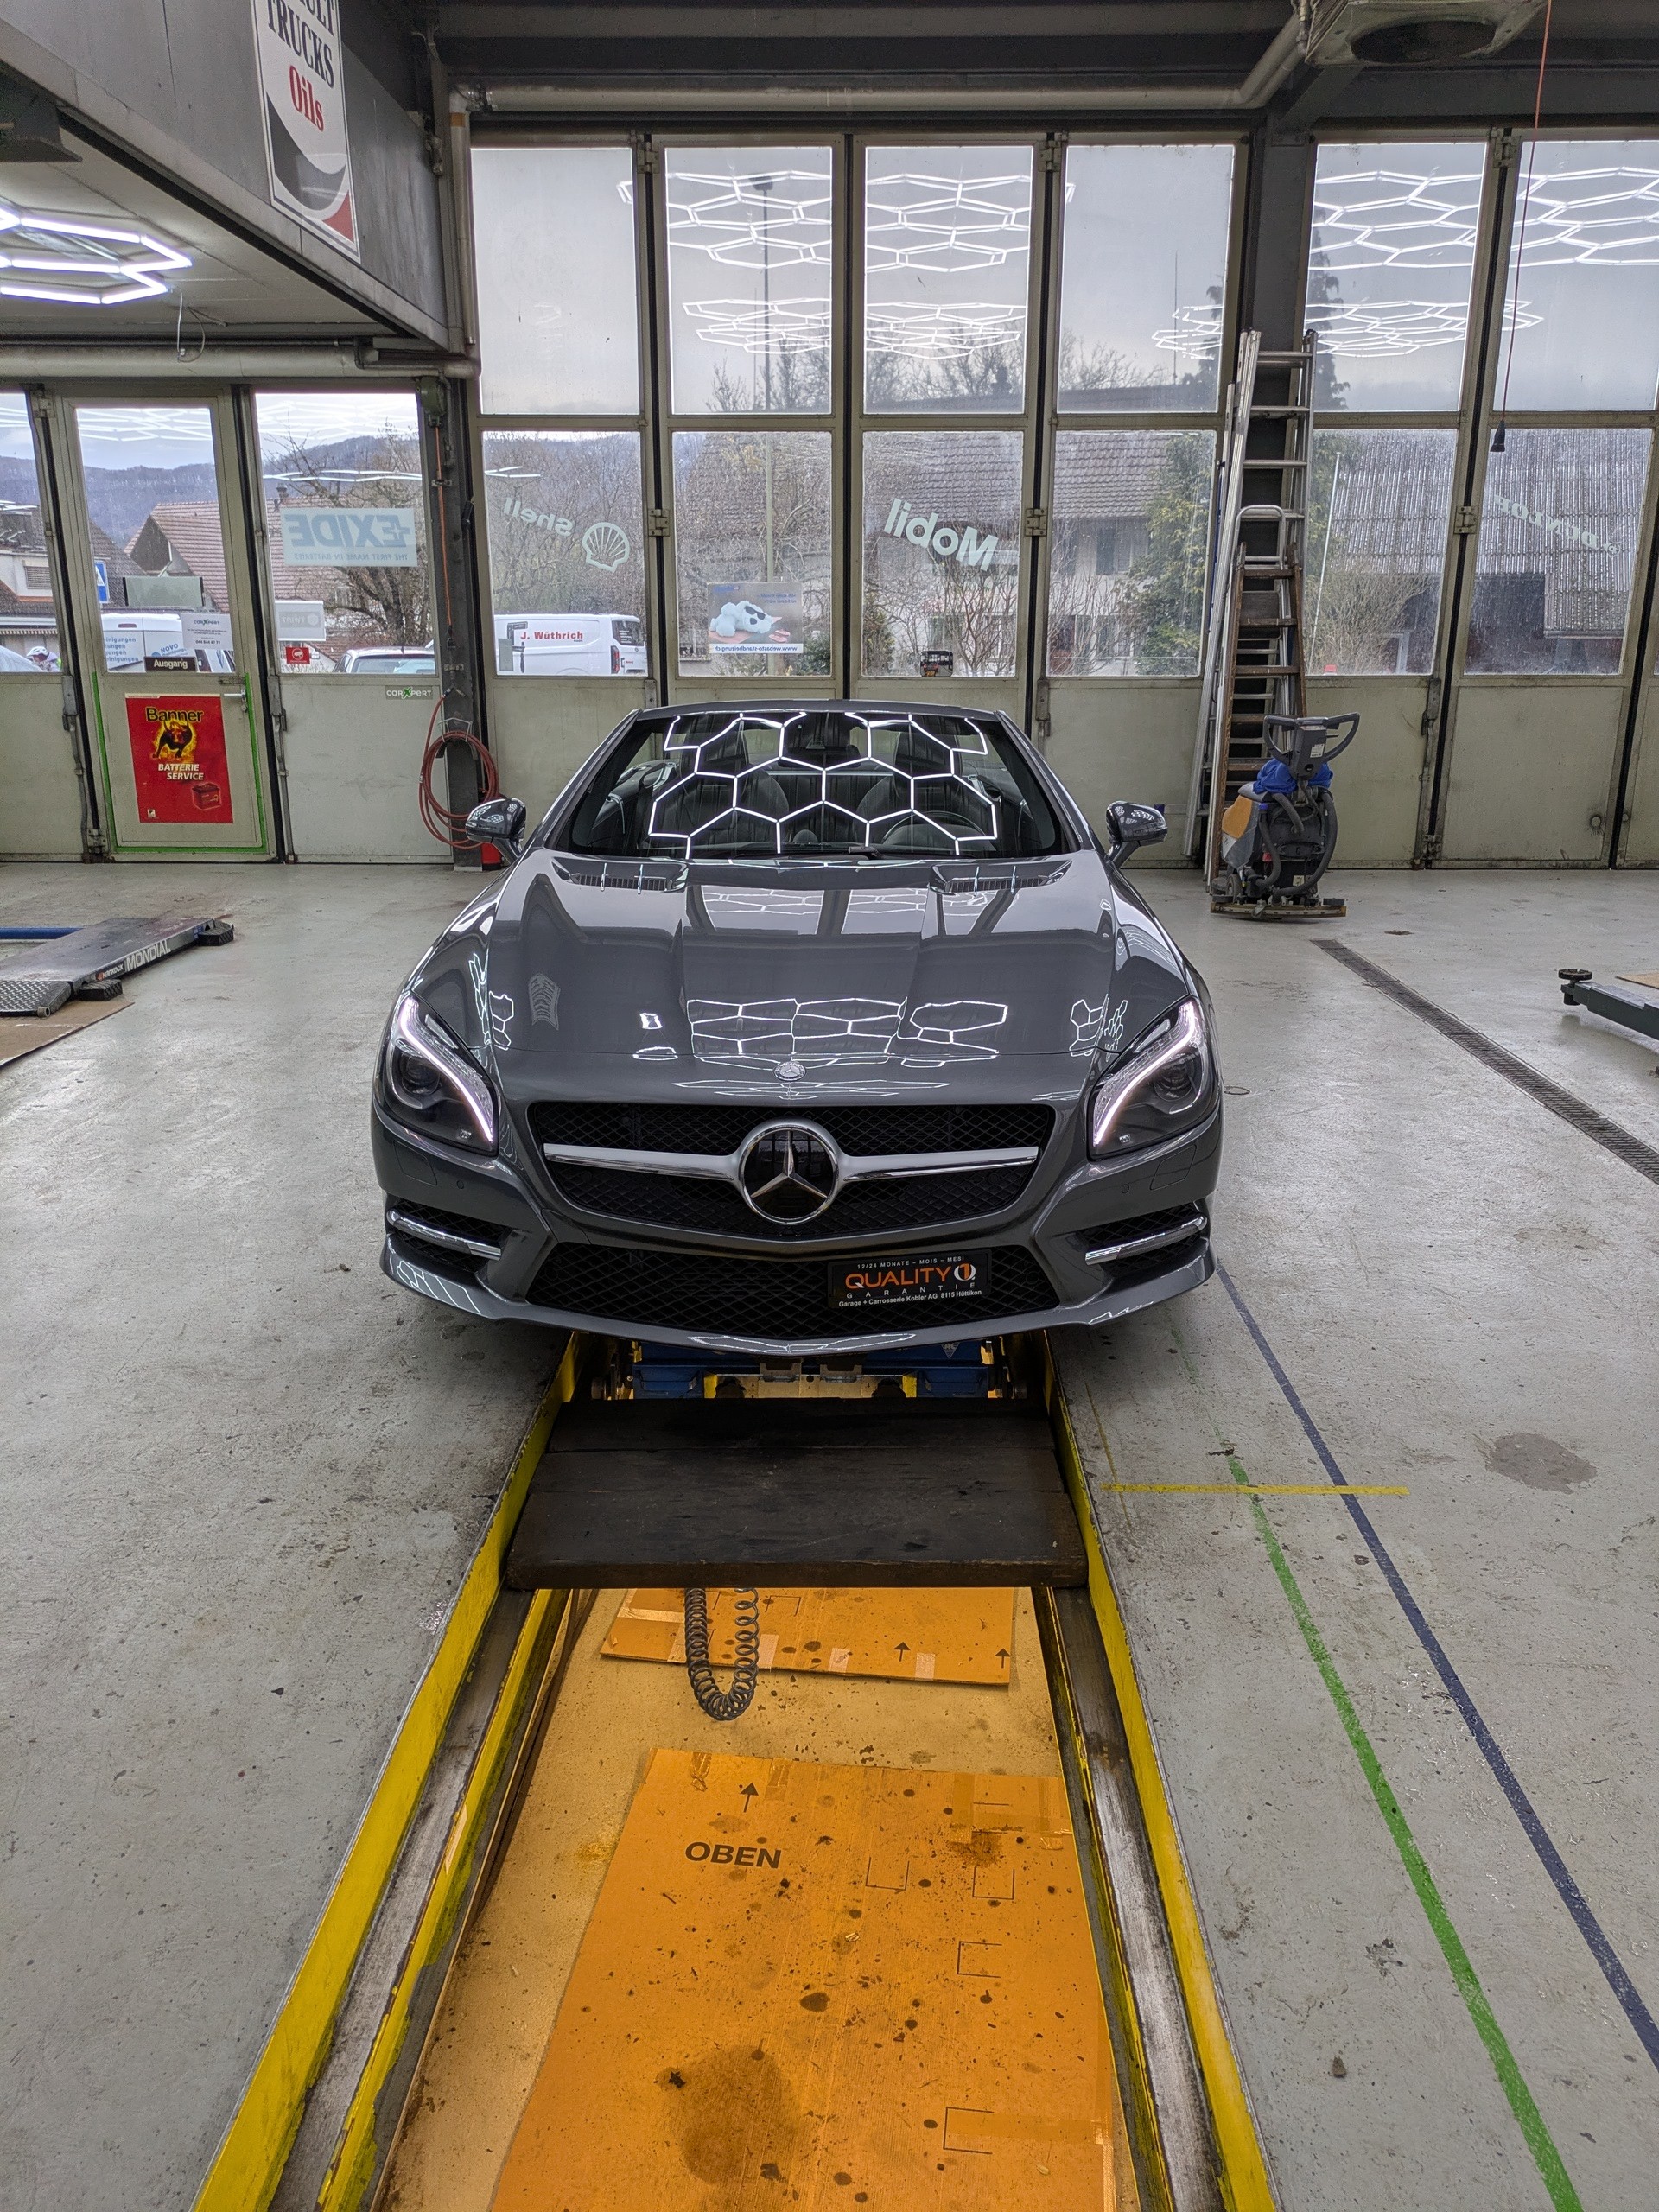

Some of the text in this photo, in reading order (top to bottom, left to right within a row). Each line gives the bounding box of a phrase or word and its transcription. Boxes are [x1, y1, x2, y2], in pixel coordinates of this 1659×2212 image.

[267, 0, 334, 89] TRUCKS
[289, 65, 324, 131] Oils
[520, 632, 530, 640] J.
[153, 658, 188, 670] Ausgang
[145, 706, 204, 722] Banner
[158, 763, 200, 772] BATTERIE
[126, 939, 171, 972] MONDIAL
[845, 1266, 952, 1289] QUALITY
[684, 1841, 782, 1869] OBEN
